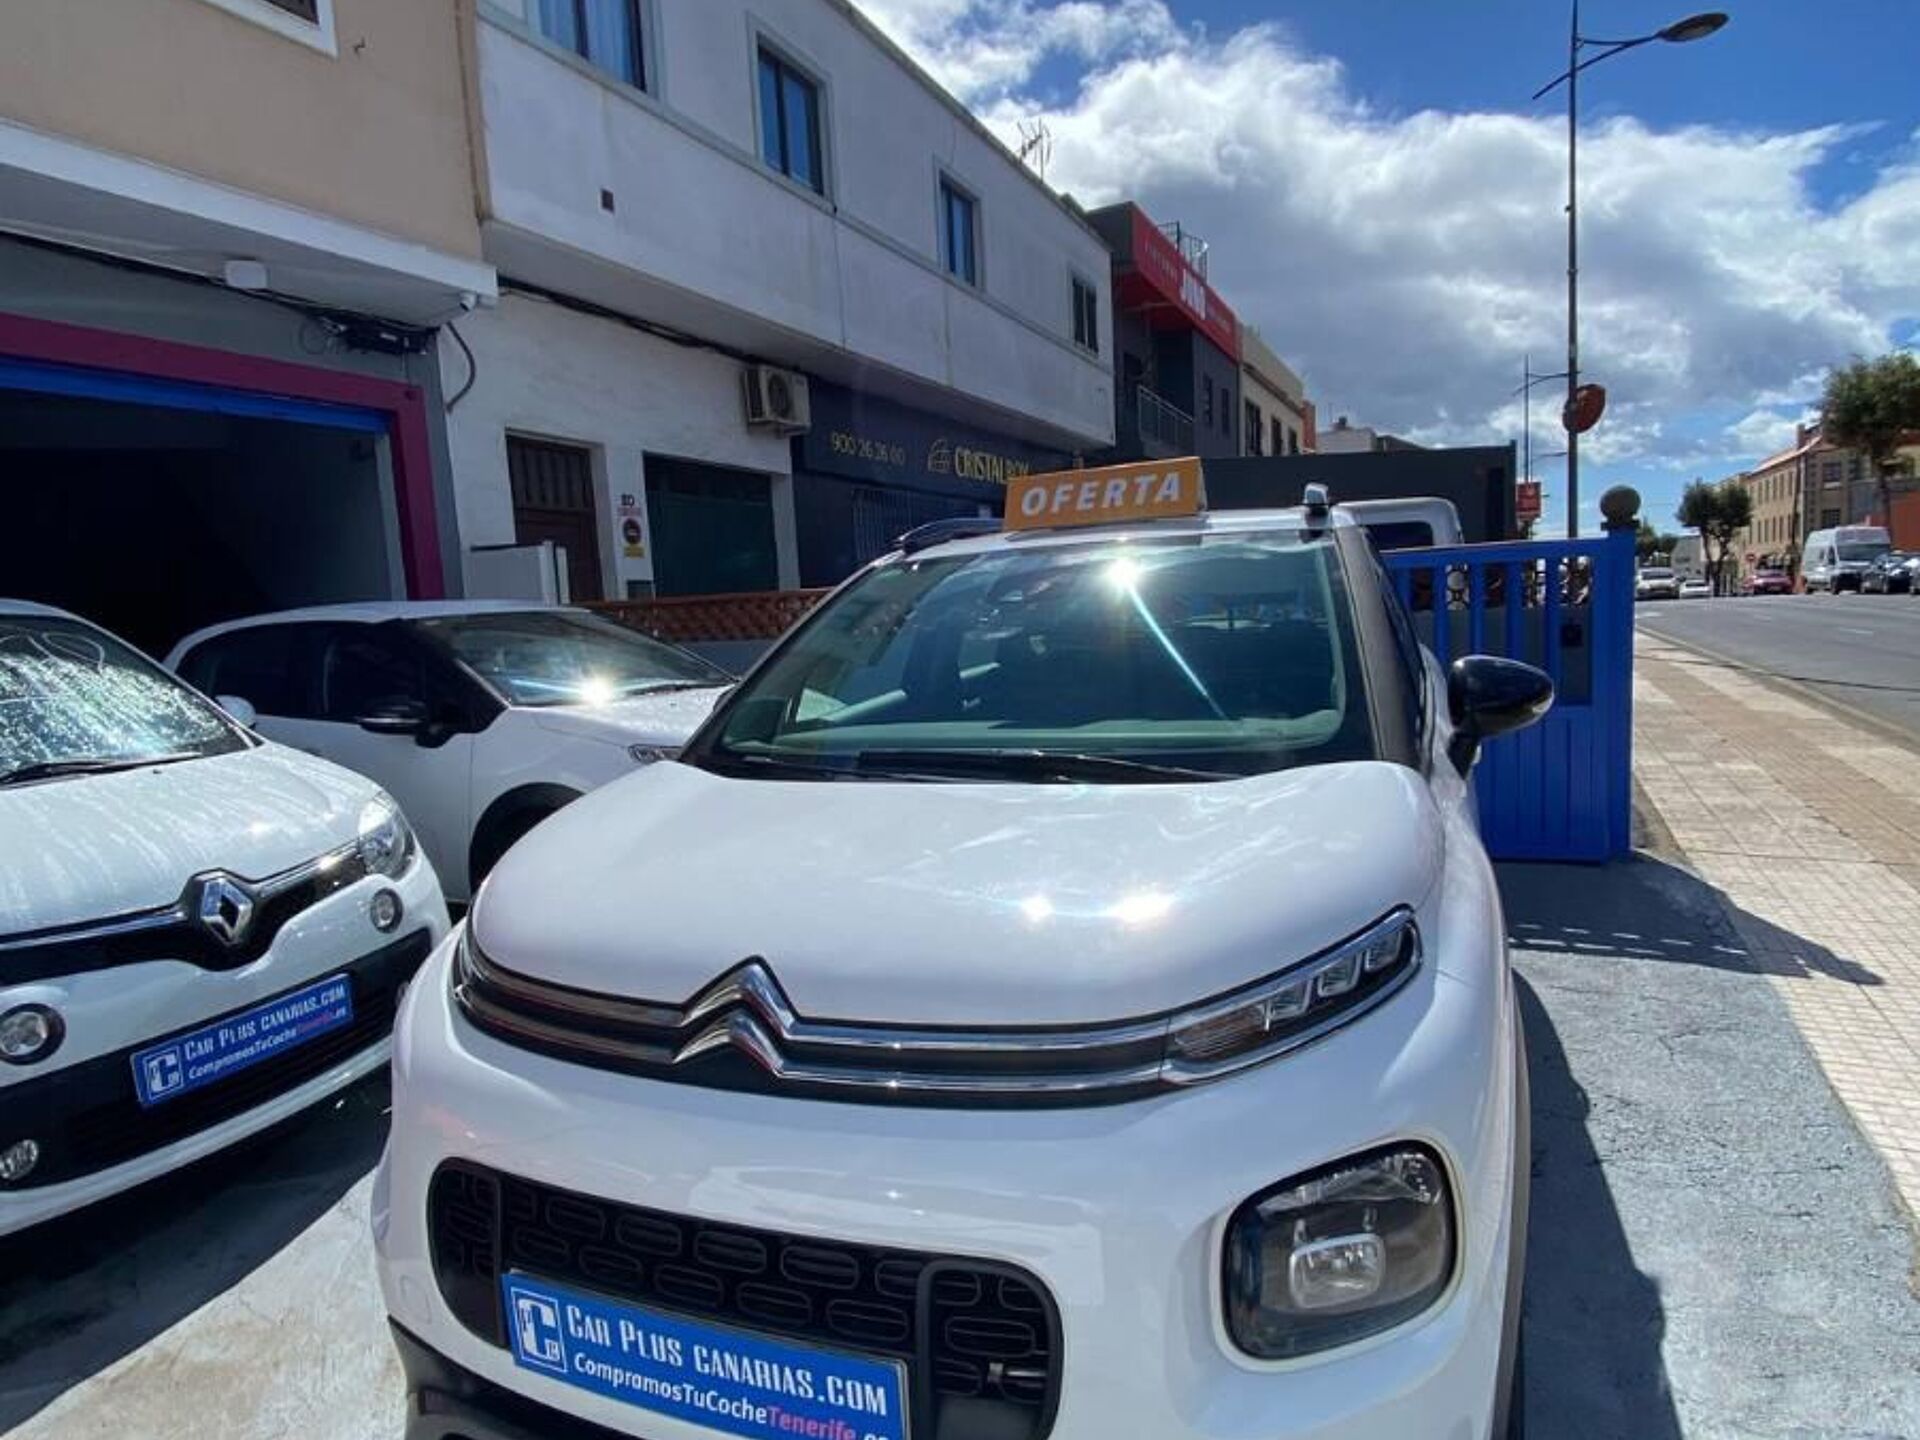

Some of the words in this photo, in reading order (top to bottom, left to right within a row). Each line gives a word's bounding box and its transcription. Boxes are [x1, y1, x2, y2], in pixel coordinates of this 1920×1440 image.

[1021, 472, 1180, 516] OFERTA
[219, 1020, 256, 1048] PLUS
[566, 1305, 611, 1348] CAR
[619, 1319, 684, 1367] PLUS
[693, 1344, 887, 1416] CANARIAS.COM
[574, 1352, 889, 1440] CompramosTuCocheTenerife
